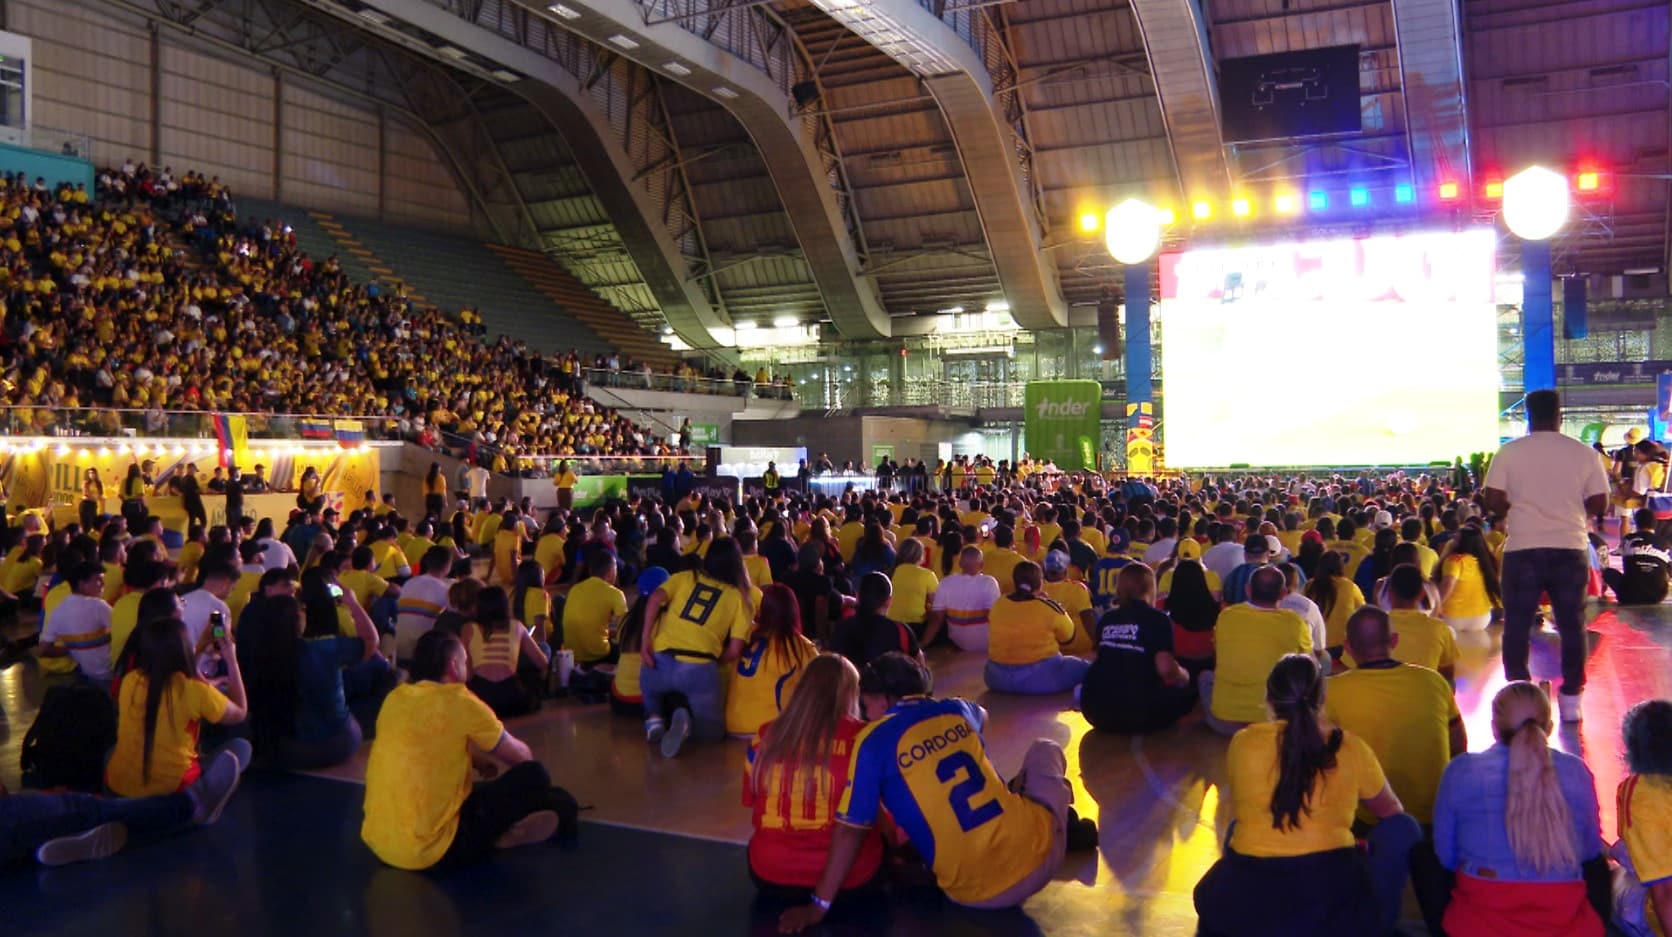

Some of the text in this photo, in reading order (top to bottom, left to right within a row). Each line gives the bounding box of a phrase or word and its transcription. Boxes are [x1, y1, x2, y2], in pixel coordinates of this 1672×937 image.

[679, 582, 723, 626] 8
[1098, 567, 1120, 595] 10
[761, 762, 833, 830] 10
[935, 750, 1004, 833] 2
